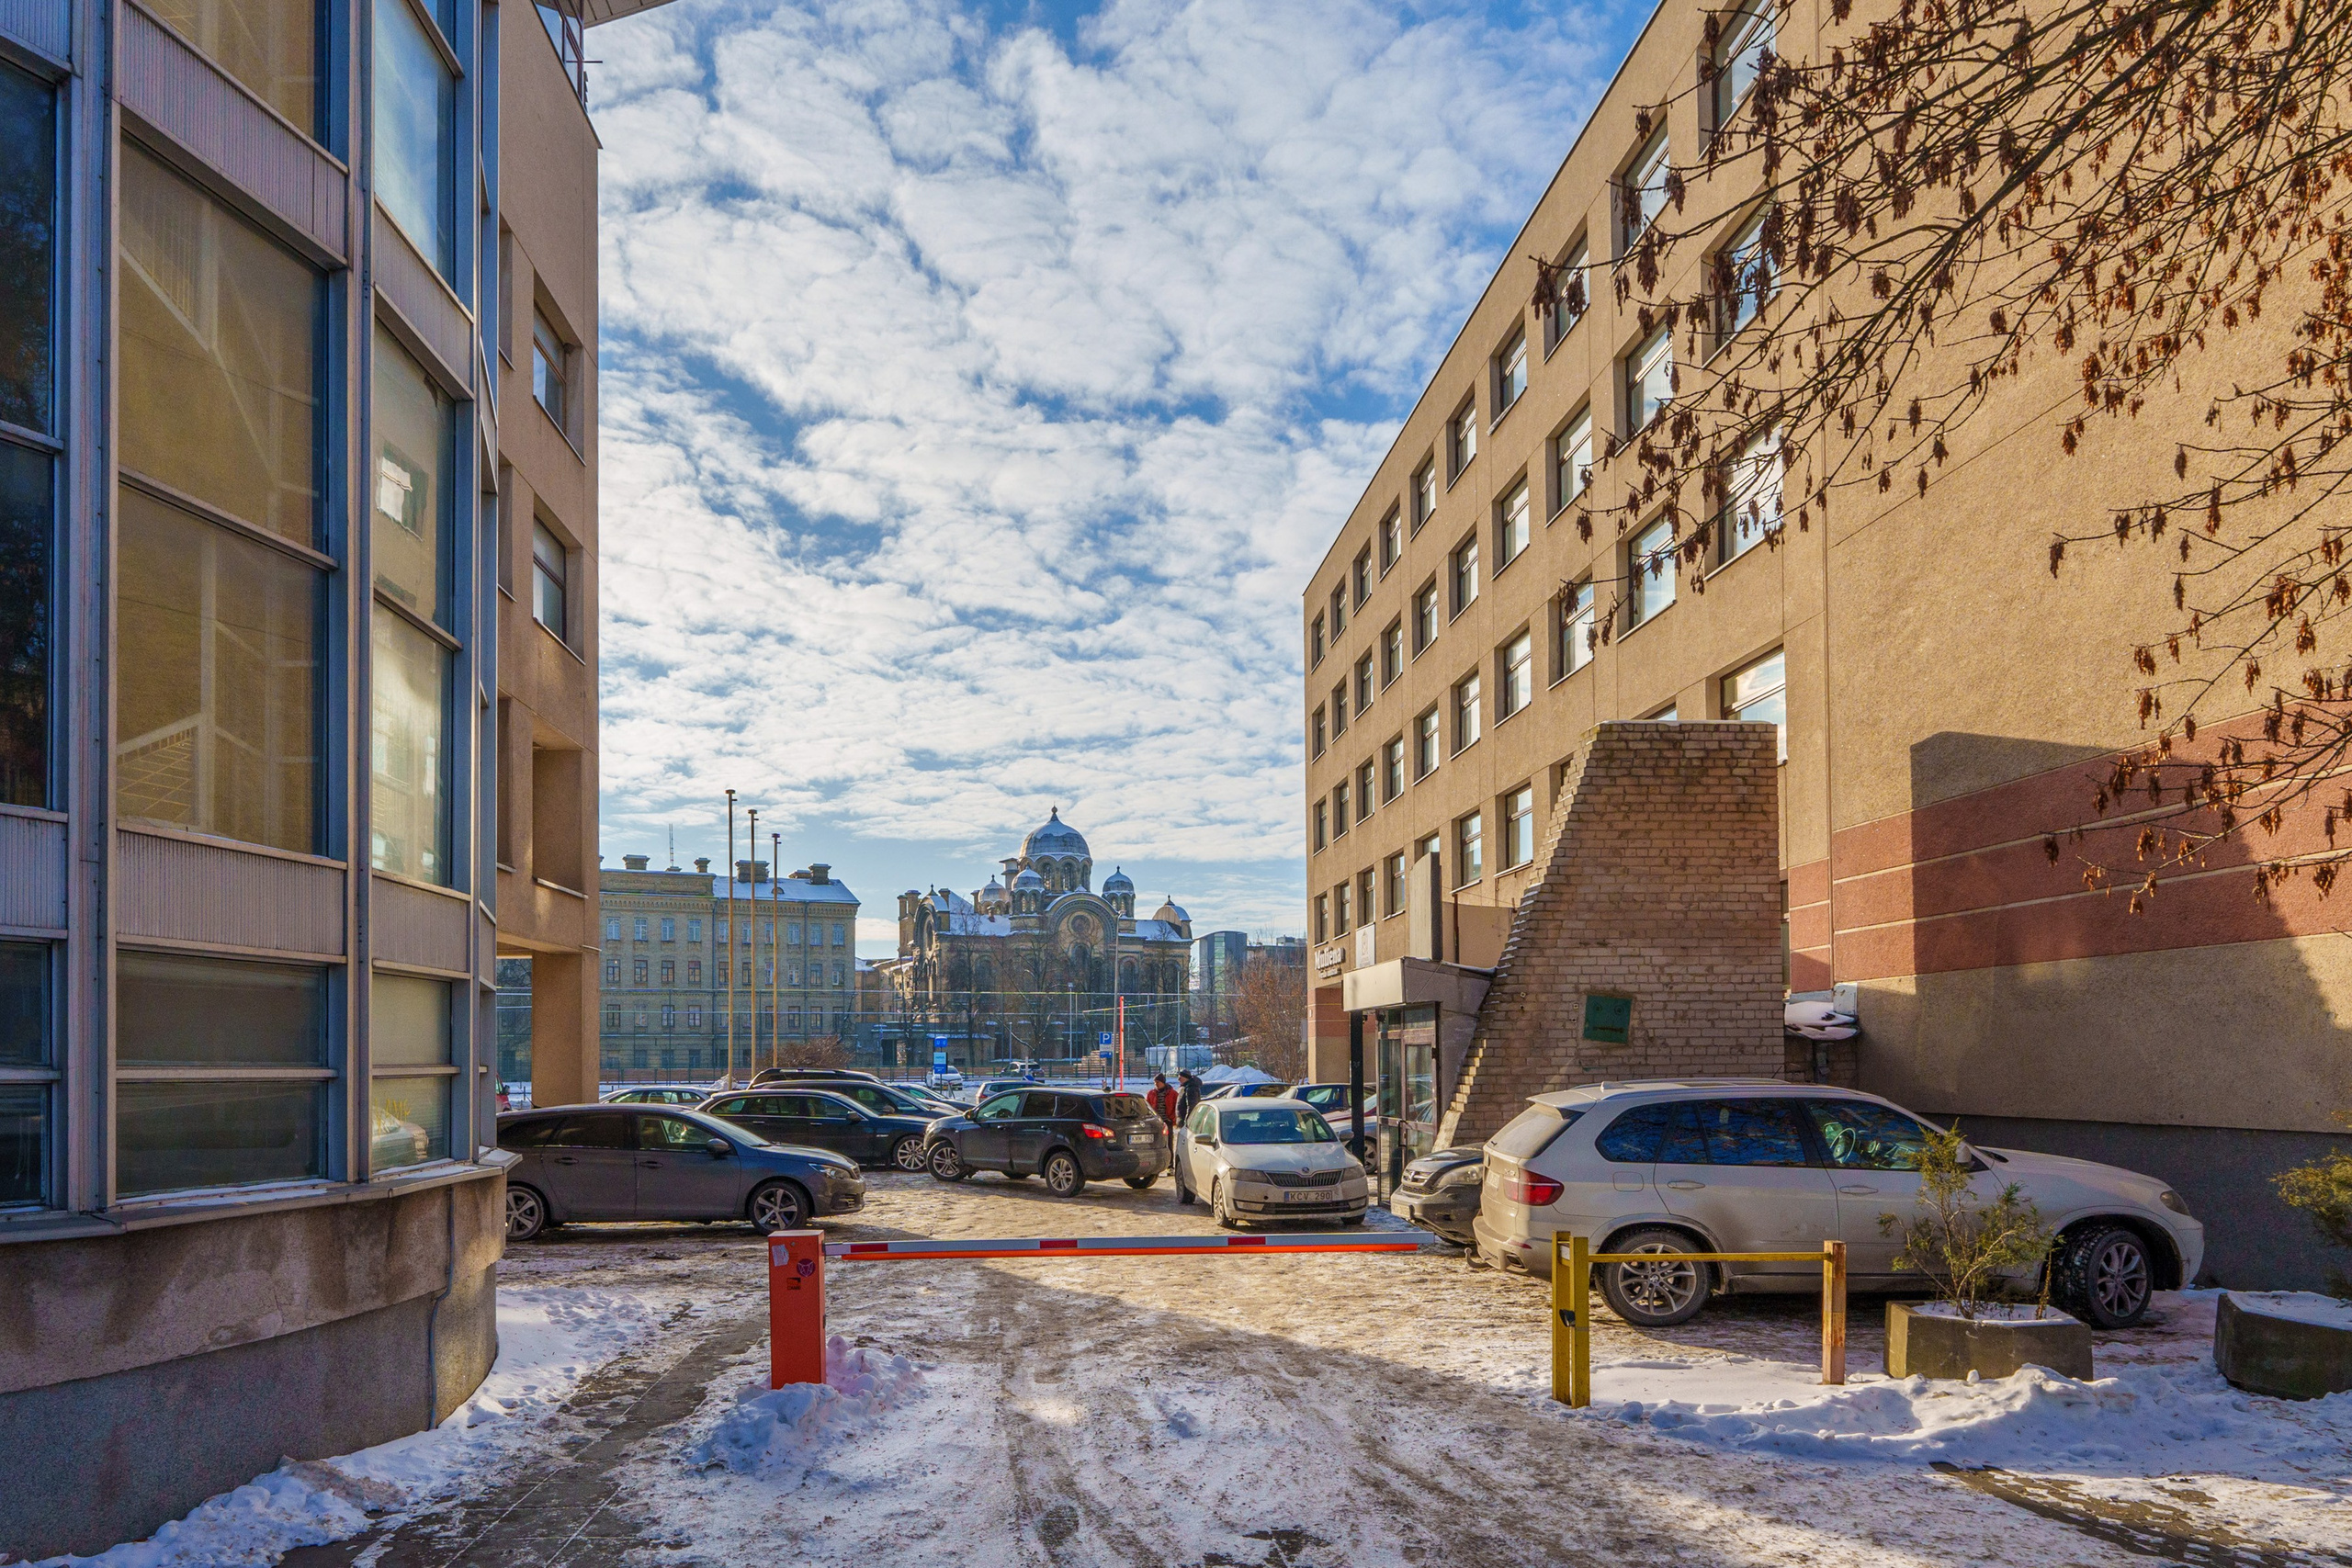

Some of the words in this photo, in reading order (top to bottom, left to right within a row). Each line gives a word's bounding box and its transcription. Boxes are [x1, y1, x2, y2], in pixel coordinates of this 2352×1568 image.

[1102, 1032, 1111, 1043] P
[1290, 1192, 1309, 1201] KCV
[1315, 1192, 1330, 1201] 290
